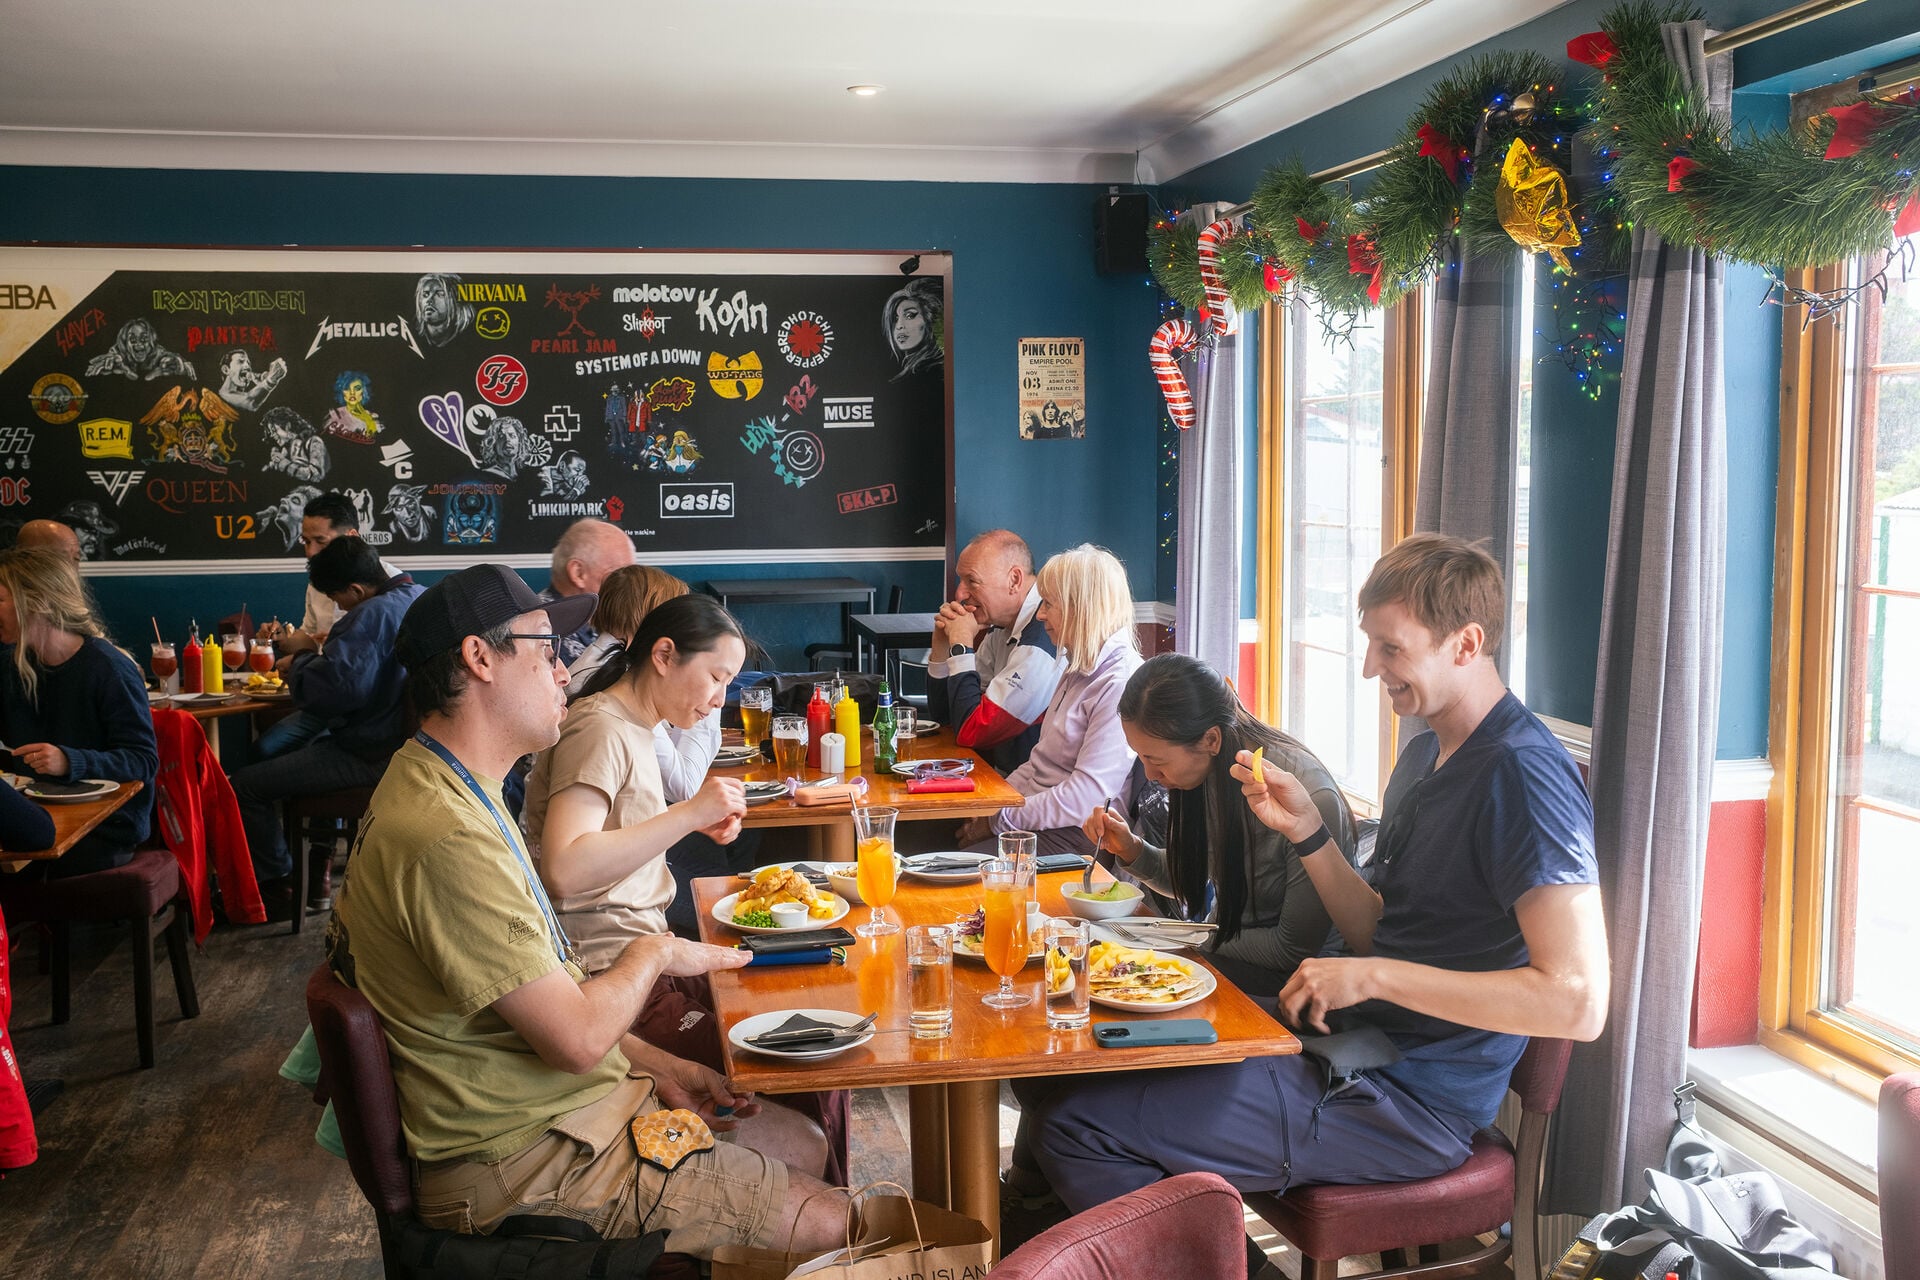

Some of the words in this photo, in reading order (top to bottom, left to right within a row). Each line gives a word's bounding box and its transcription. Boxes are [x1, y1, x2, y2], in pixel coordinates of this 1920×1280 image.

[153, 289, 209, 314] IRON
[210, 290, 306, 315] MAIDEN
[457, 283, 527, 303] NIRVANA
[612, 283, 697, 303] molotov
[55, 307, 108, 358] SLAYER
[187, 325, 278, 353] PANTERA
[304, 313, 425, 361] METALLICA
[531, 338, 580, 354] PEARL
[585, 338, 618, 354] JAM
[1022, 343, 1046, 356] PINK
[1048, 343, 1080, 356] FLOYD
[575, 353, 632, 376] SYSTEM
[632, 351, 649, 367] OF
[650, 350, 663, 366] A
[661, 348, 702, 366] DOWN
[706, 370, 763, 380] WU-TANG
[823, 404, 873, 421] MUSE
[85, 427, 127, 441] R.E.M.
[146, 477, 248, 514] QUEEN
[427, 483, 508, 496] JOURNEY
[841, 487, 891, 512] SKA-P
[531, 501, 570, 517] LINKIN
[571, 502, 604, 516] PARK
[664, 489, 731, 512] oasis
[213, 515, 257, 540] U2
[634, 528, 656, 536] machine
